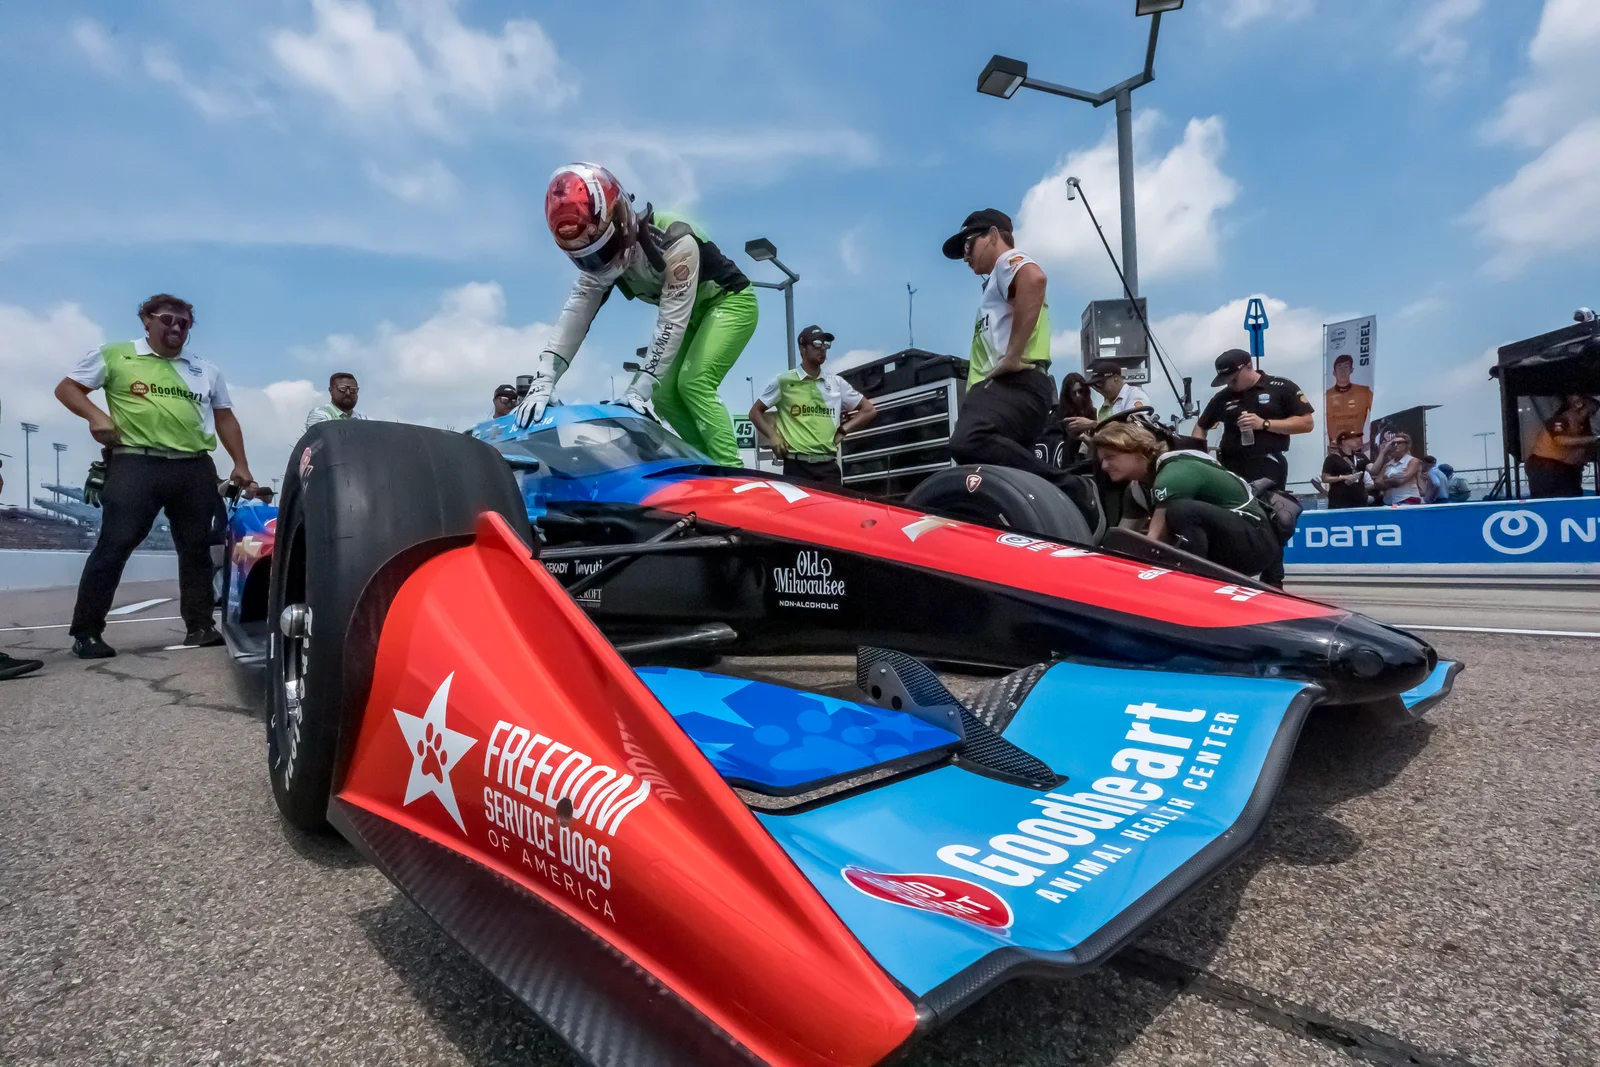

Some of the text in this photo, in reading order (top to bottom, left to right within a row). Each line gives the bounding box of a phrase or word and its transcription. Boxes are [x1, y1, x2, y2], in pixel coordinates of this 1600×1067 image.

[645, 349, 664, 374] Seek
[1359, 320, 1371, 367] SIEGEL
[801, 404, 836, 416] Goodheart
[736, 423, 753, 436] 45
[1560, 517, 1600, 543] N
[773, 566, 845, 596] Milwaukee
[796, 550, 832, 577] Old
[483, 719, 650, 836] FREEDOM
[936, 702, 1207, 887] Goodheart
[1035, 712, 1239, 904] ANIMAL HEALTH CENTER
[483, 785, 611, 891] SERVICE DOGS
[488, 829, 616, 923] OF AMERICA
